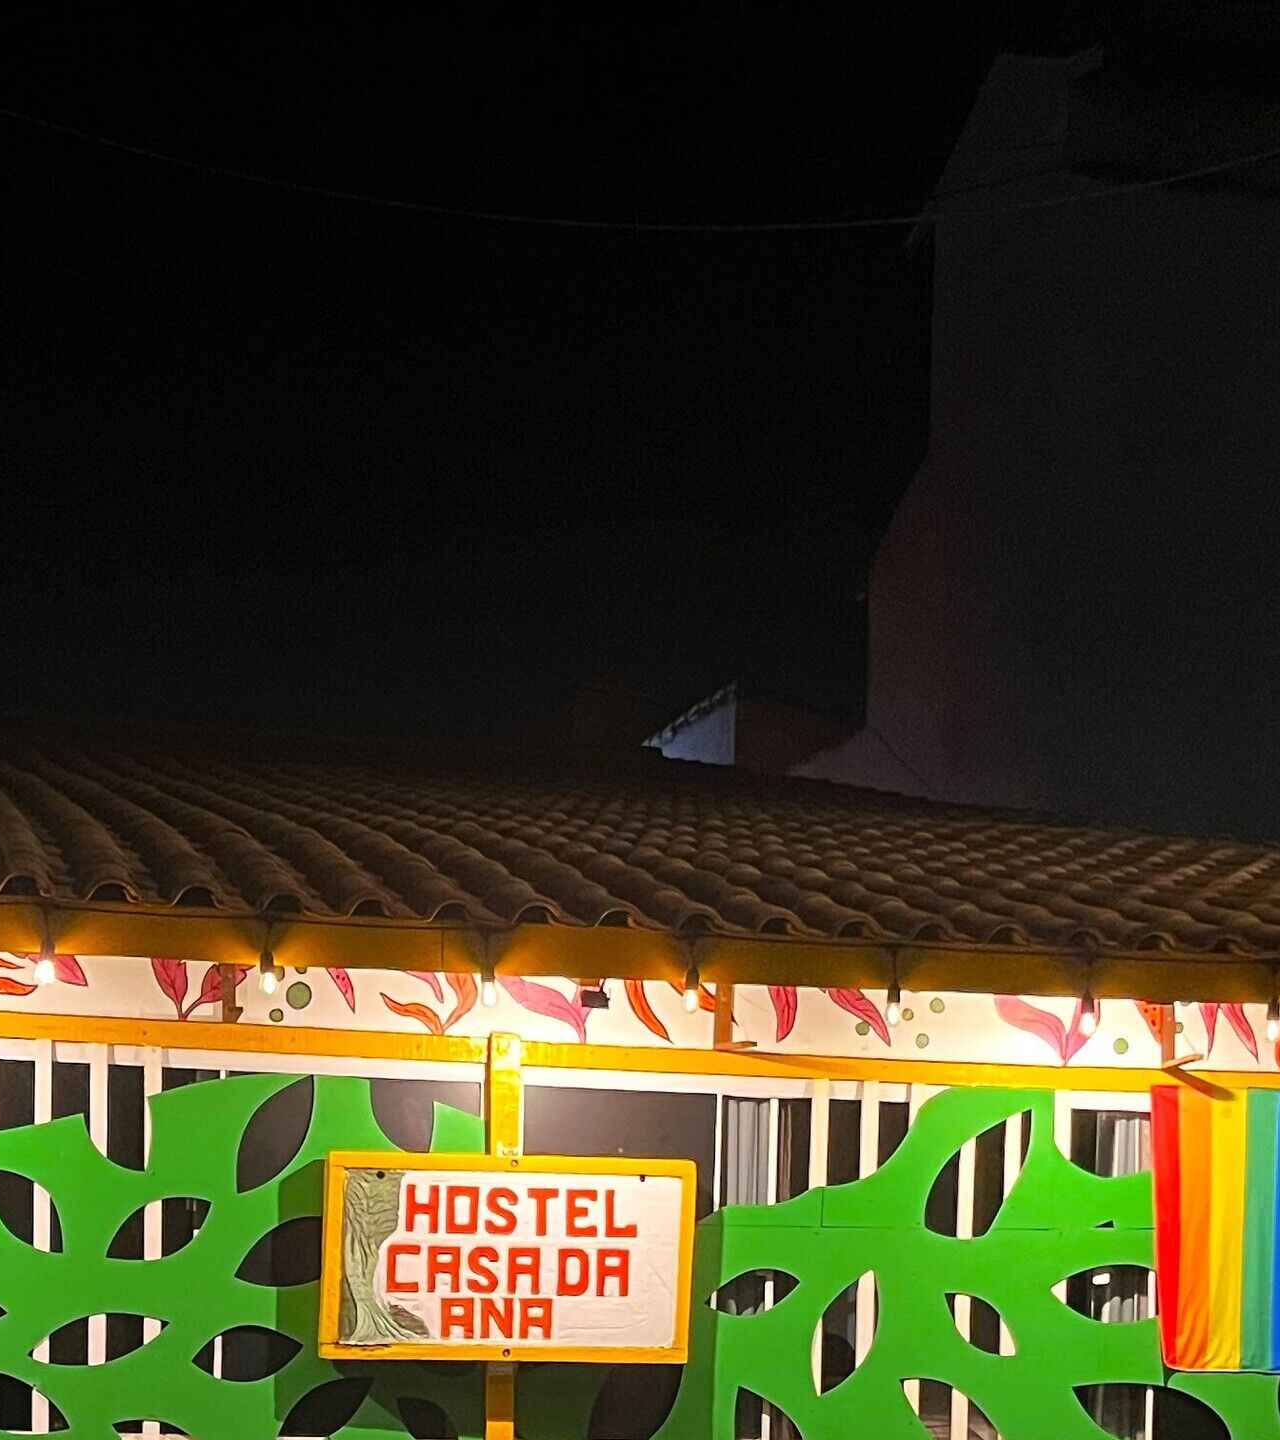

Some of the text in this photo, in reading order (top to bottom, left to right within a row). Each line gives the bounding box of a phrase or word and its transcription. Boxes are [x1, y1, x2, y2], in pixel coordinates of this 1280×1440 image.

[405, 1184, 637, 1238] HOSTEL
[386, 1244, 630, 1296] CASA DA
[440, 1297, 554, 1340] ANA
